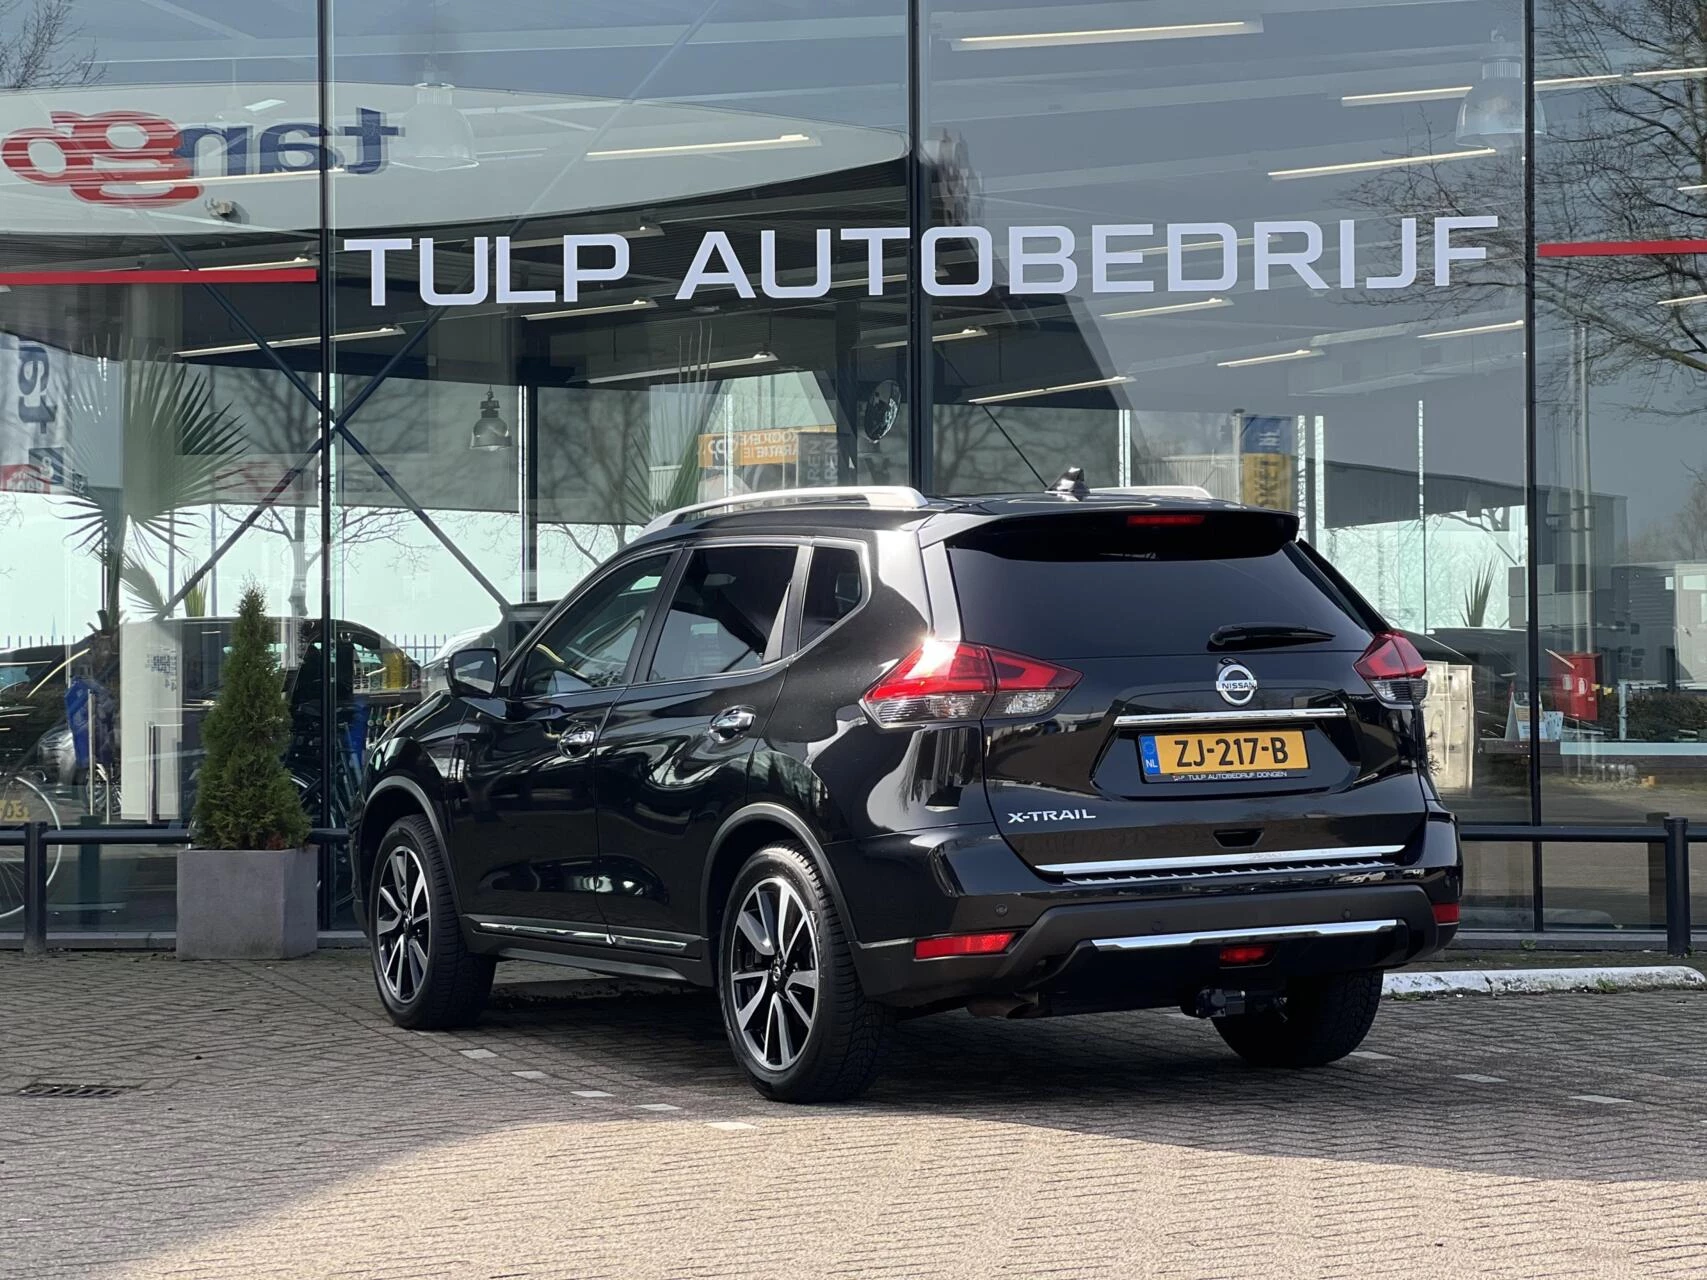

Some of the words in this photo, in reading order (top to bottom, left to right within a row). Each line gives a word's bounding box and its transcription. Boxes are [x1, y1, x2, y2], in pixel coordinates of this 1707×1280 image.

[343, 233, 630, 306] TULP
[675, 215, 1499, 301] AUTOBEDRIJF
[1221, 681, 1256, 689] NISSAN
[1145, 759, 1158, 768] NL
[1174, 737, 1289, 768] ZJ-217-B
[1007, 808, 1097, 824] X-TRAIL
